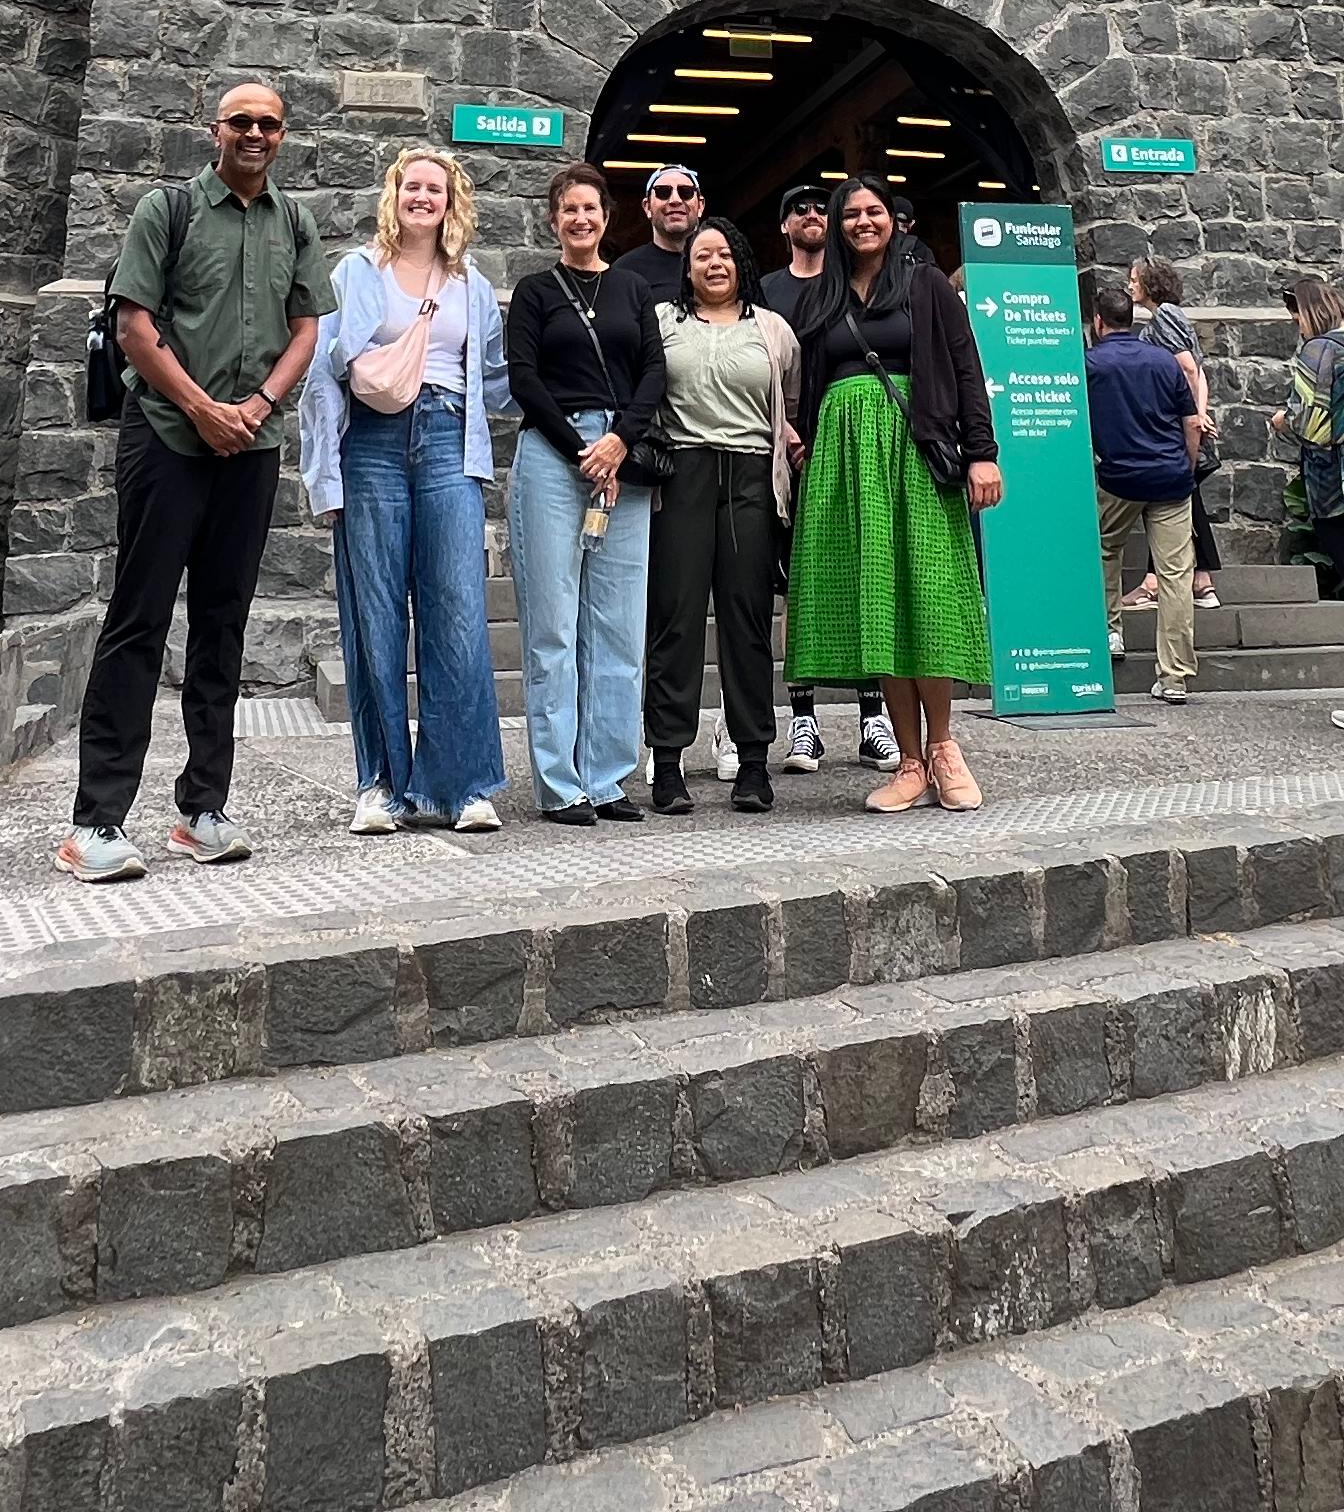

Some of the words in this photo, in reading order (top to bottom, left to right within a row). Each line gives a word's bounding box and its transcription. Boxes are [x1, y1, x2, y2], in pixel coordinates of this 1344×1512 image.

[477, 115, 527, 133] Salida
[1131, 147, 1185, 162] Entrada
[1004, 222, 1061, 236] Funicular
[1016, 235, 1061, 248] Santiago
[1002, 291, 1050, 306] Compra
[1004, 309, 1022, 322] De
[1024, 309, 1067, 323] Tickets
[1005, 326, 1034, 335] Compra
[1035, 326, 1045, 335] de
[1046, 326, 1070, 335] tickets
[1009, 372, 1051, 385] Acceso
[1054, 372, 1080, 386] solo
[1010, 392, 1033, 403] con
[1035, 390, 1072, 403] ticket
[1071, 682, 1104, 693] turistik
